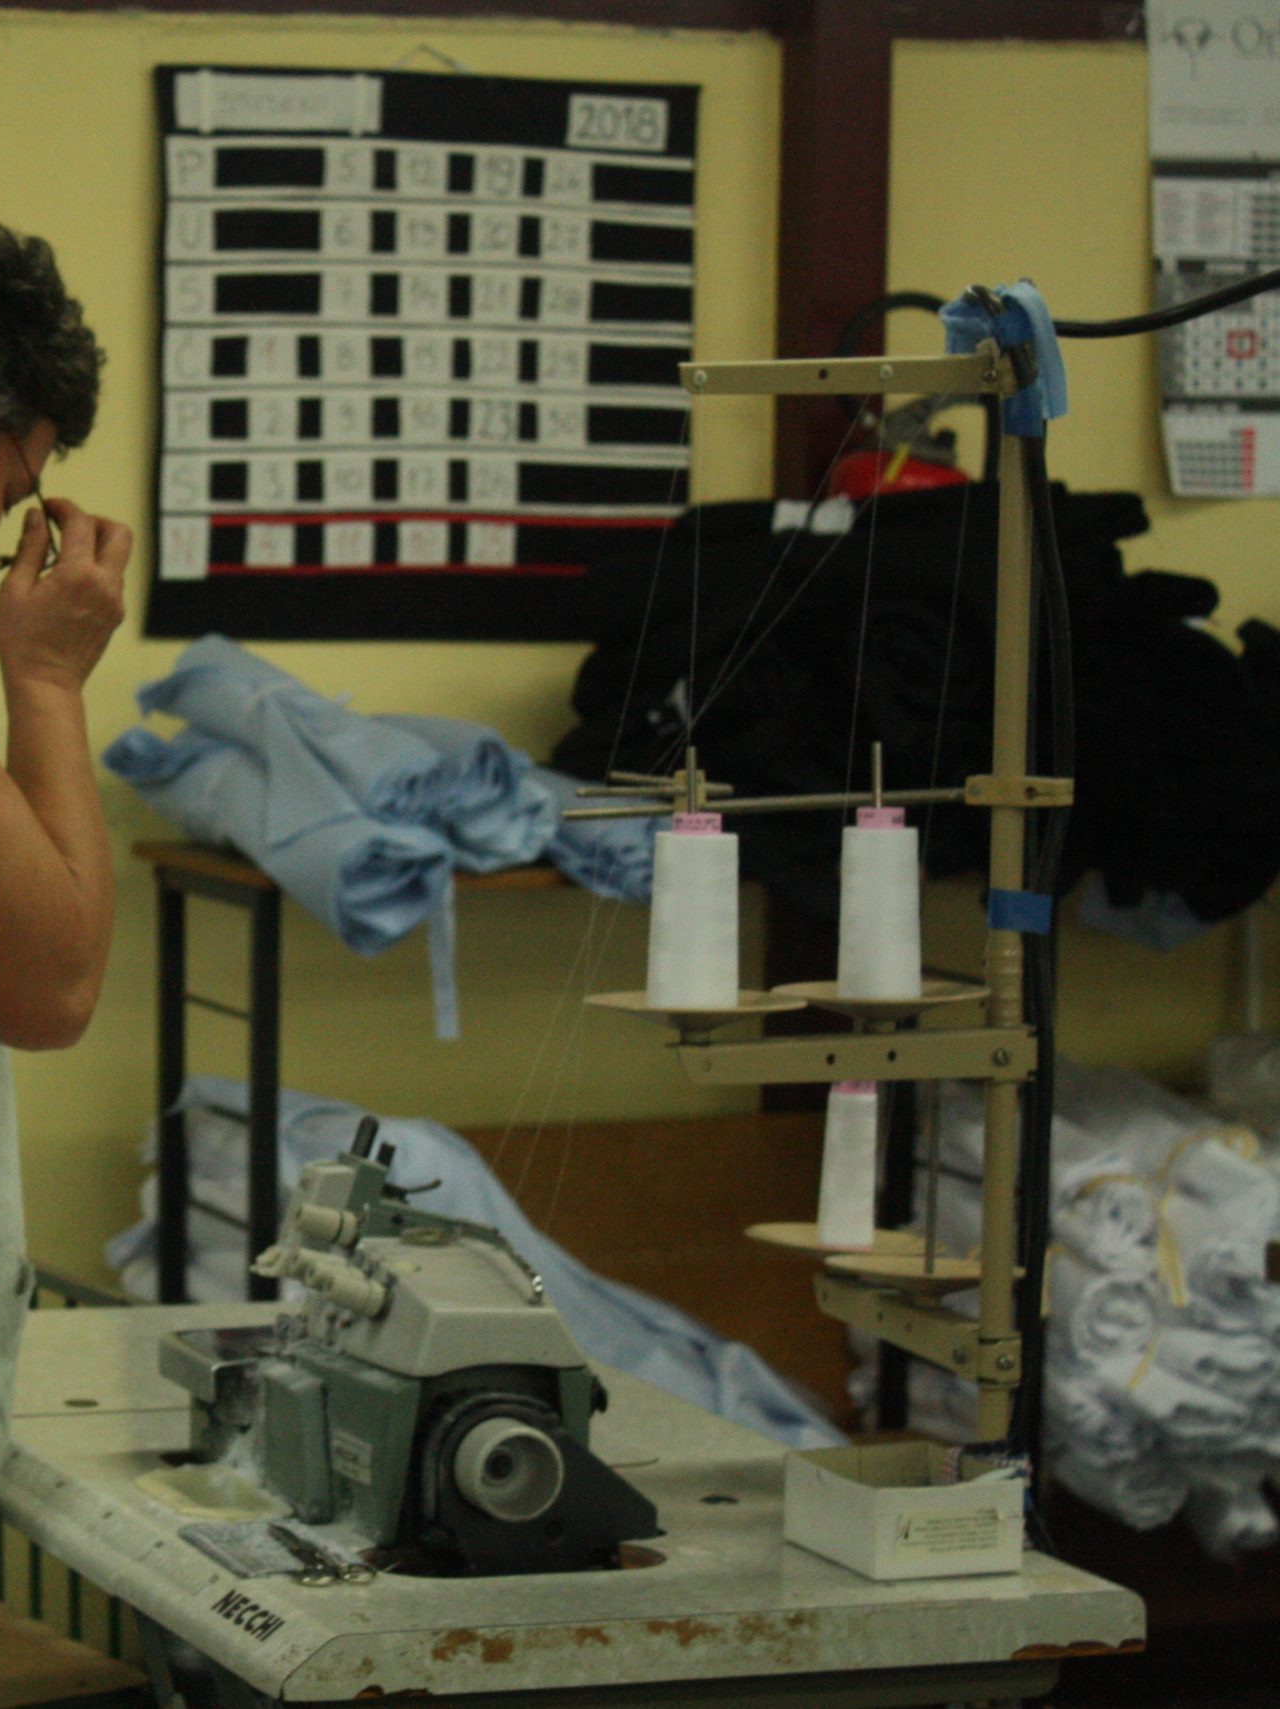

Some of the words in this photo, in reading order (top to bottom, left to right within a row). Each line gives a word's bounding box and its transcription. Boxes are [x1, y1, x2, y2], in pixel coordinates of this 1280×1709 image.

[577, 103, 657, 144] 2018
[175, 149, 205, 186] P
[336, 148, 361, 184] 5
[484, 154, 516, 197] 19
[177, 206, 204, 250] U
[333, 208, 356, 247] 6
[177, 274, 205, 314] S
[176, 400, 202, 439] P
[478, 399, 517, 442] 23
[171, 463, 201, 506] S
[211, 1588, 285, 1641] NECCHI
